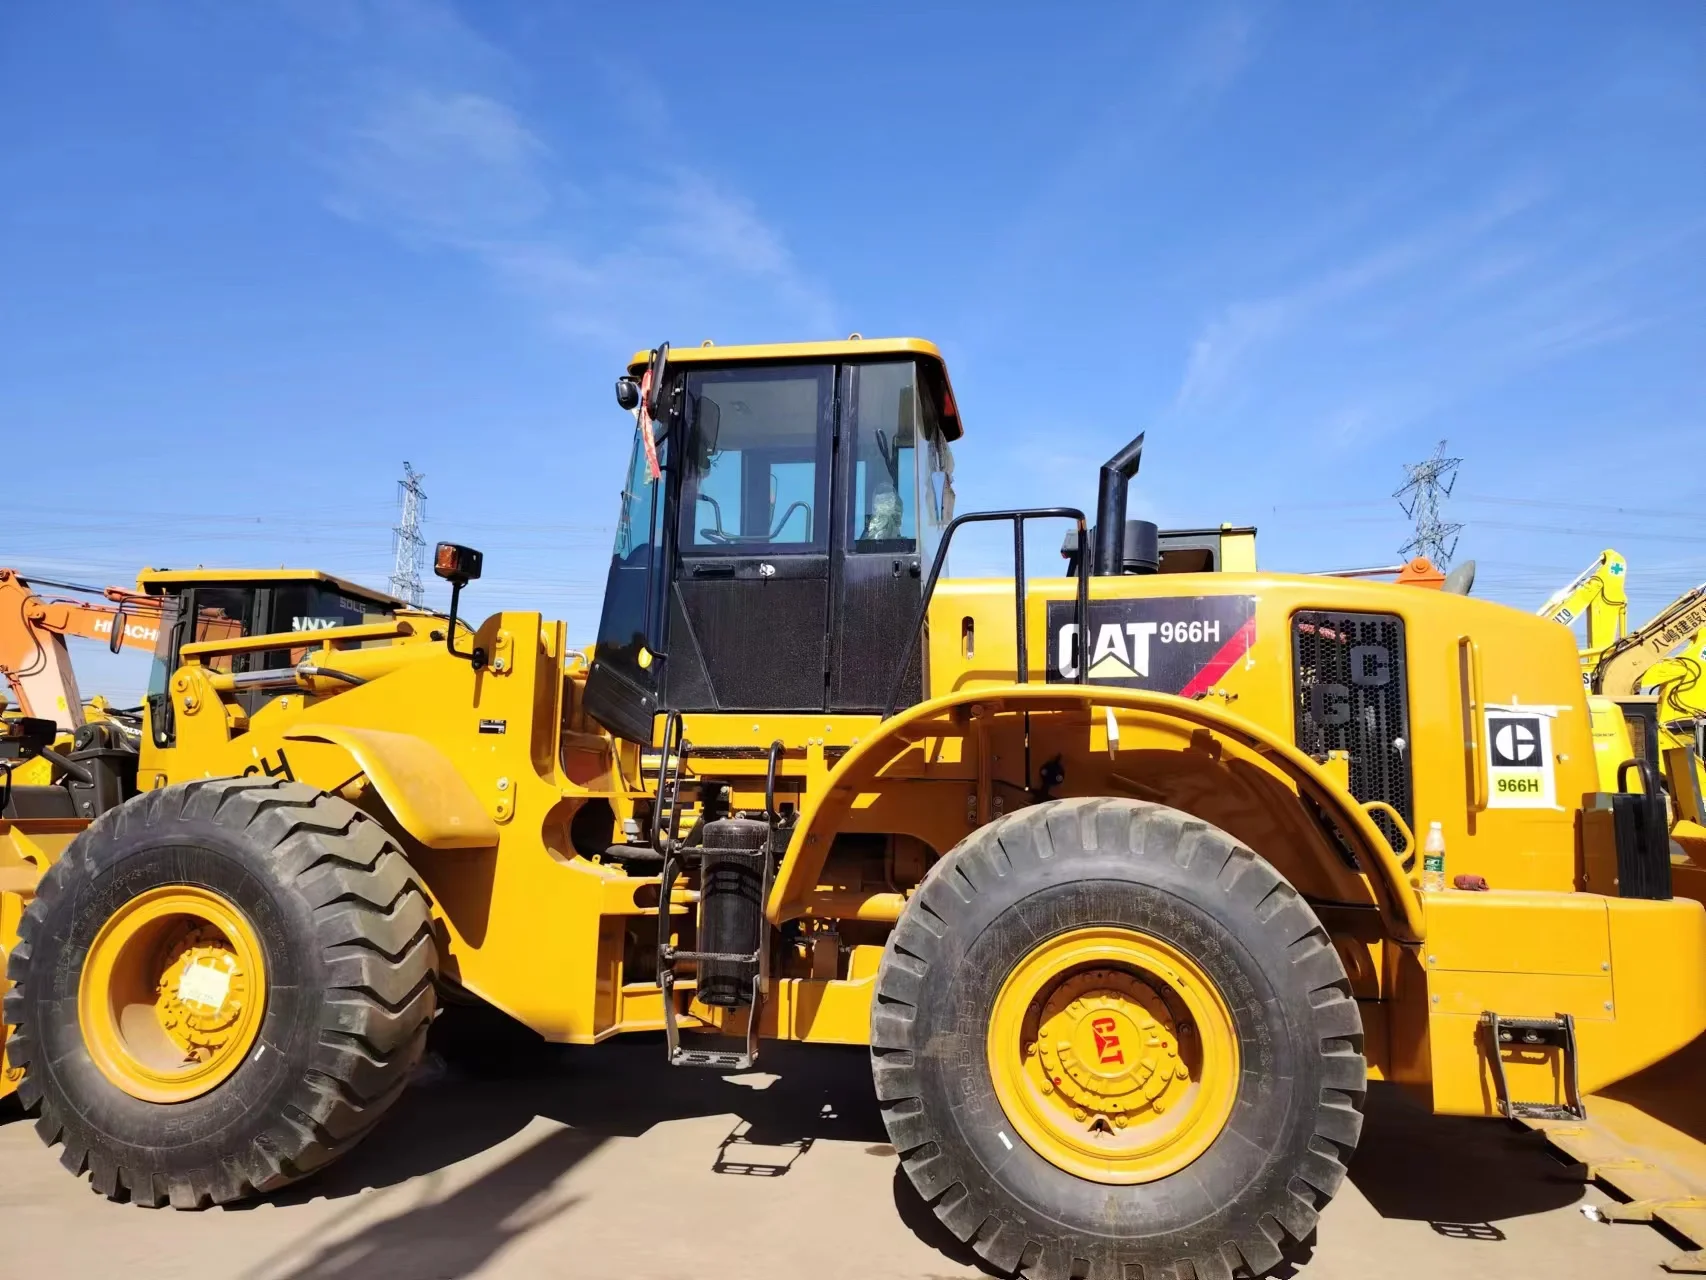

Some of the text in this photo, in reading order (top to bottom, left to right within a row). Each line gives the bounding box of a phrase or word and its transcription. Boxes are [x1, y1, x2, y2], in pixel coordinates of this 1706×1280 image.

[1059, 620, 1219, 678] CAT 966H
[1497, 778, 1539, 792] 966H
[1091, 1017, 1124, 1064] CAT
